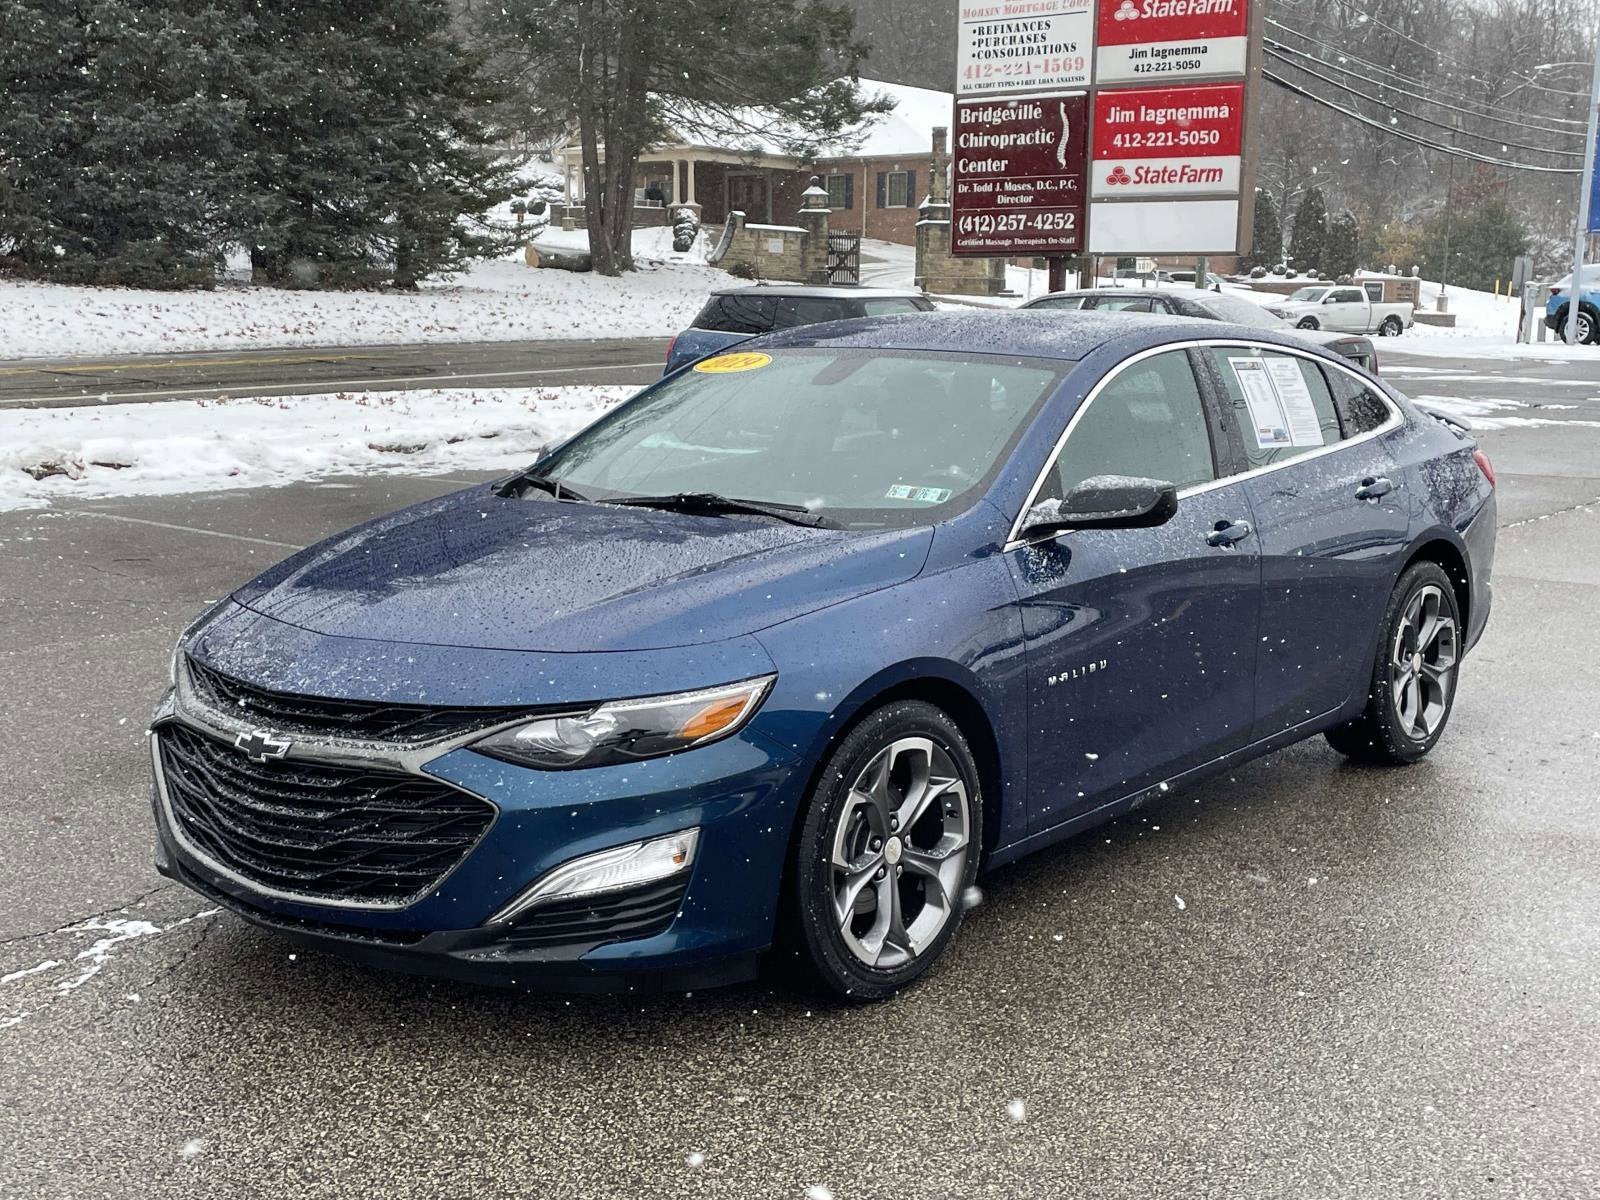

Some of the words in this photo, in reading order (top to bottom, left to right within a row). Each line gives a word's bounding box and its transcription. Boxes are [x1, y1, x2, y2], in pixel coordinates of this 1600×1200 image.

[1002, 1, 1058, 15] MORTGAGE
[977, 20, 1051, 36] REFINANCES
[977, 33, 1047, 48] PURCHASES
[977, 42, 1077, 60] CONSOLIDATIONS
[1129, 48, 1148, 59] Jim
[1151, 45, 1208, 59] Iagnemma
[963, 56, 1085, 79] 412-221-1569
[1134, 60, 1201, 73] 412-221-5050
[997, 80, 1016, 88] TYPES
[960, 104, 1042, 125] Bridgeville
[1106, 107, 1135, 124] Jim
[1140, 105, 1229, 125] Iagnemma
[959, 128, 1055, 149] Chiropractic
[1113, 130, 1220, 148] 412-221-5050
[959, 158, 1008, 173] Center
[958, 184, 971, 193] Dr.
[973, 183, 993, 192] Todd
[995, 183, 1003, 192] J.
[1004, 181, 1034, 192] Moses,
[1036, 180, 1058, 191] D.C.,
[997, 195, 1034, 205] Director
[959, 215, 995, 234] (412)
[998, 213, 1075, 231] 257-4252
[957, 238, 984, 246] Certified
[985, 238, 1012, 246] Massage
[1014, 237, 1047, 246] Therapists
[1048, 236, 1075, 245] On-Staff
[1047, 659, 1107, 687] MALIBU
